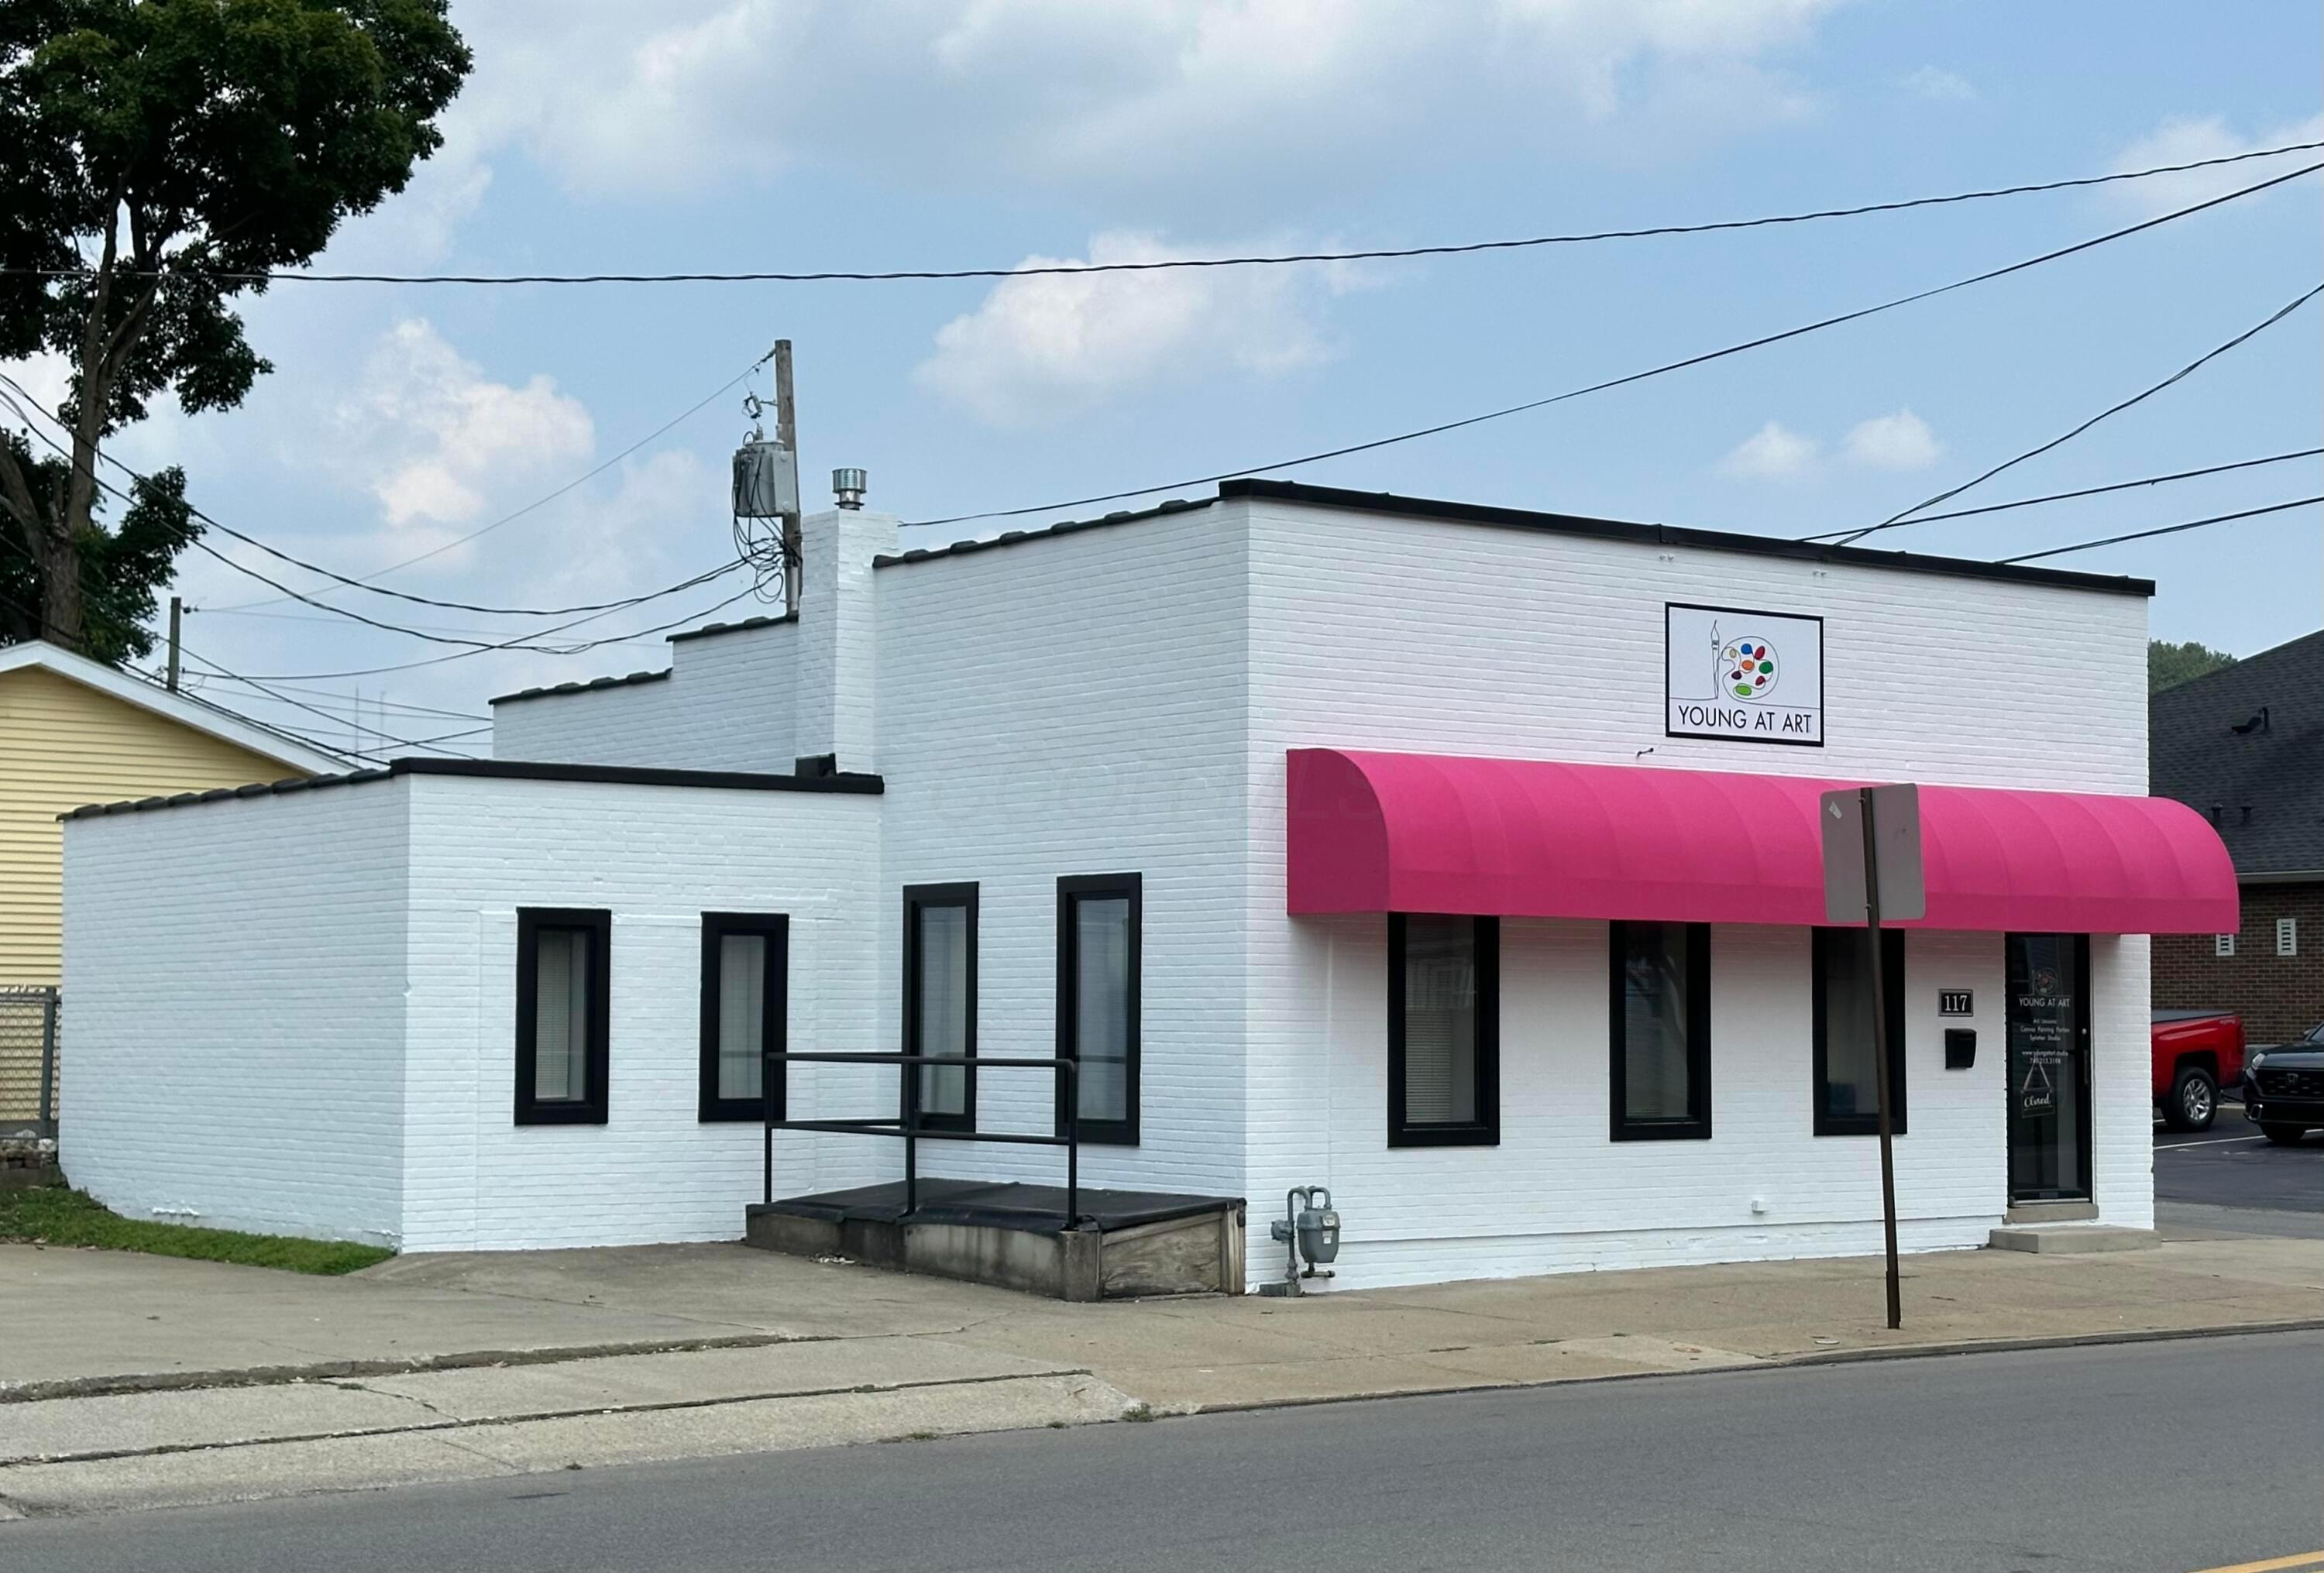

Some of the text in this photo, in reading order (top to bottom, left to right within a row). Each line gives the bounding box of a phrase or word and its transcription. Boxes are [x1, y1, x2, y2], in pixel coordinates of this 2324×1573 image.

[1679, 705, 1812, 733] YOUNG AT ART
[1944, 994, 1968, 1011] 117
[2019, 997, 2070, 1007] YOUNG AT ART
[2024, 1093, 2051, 1108] Closed
